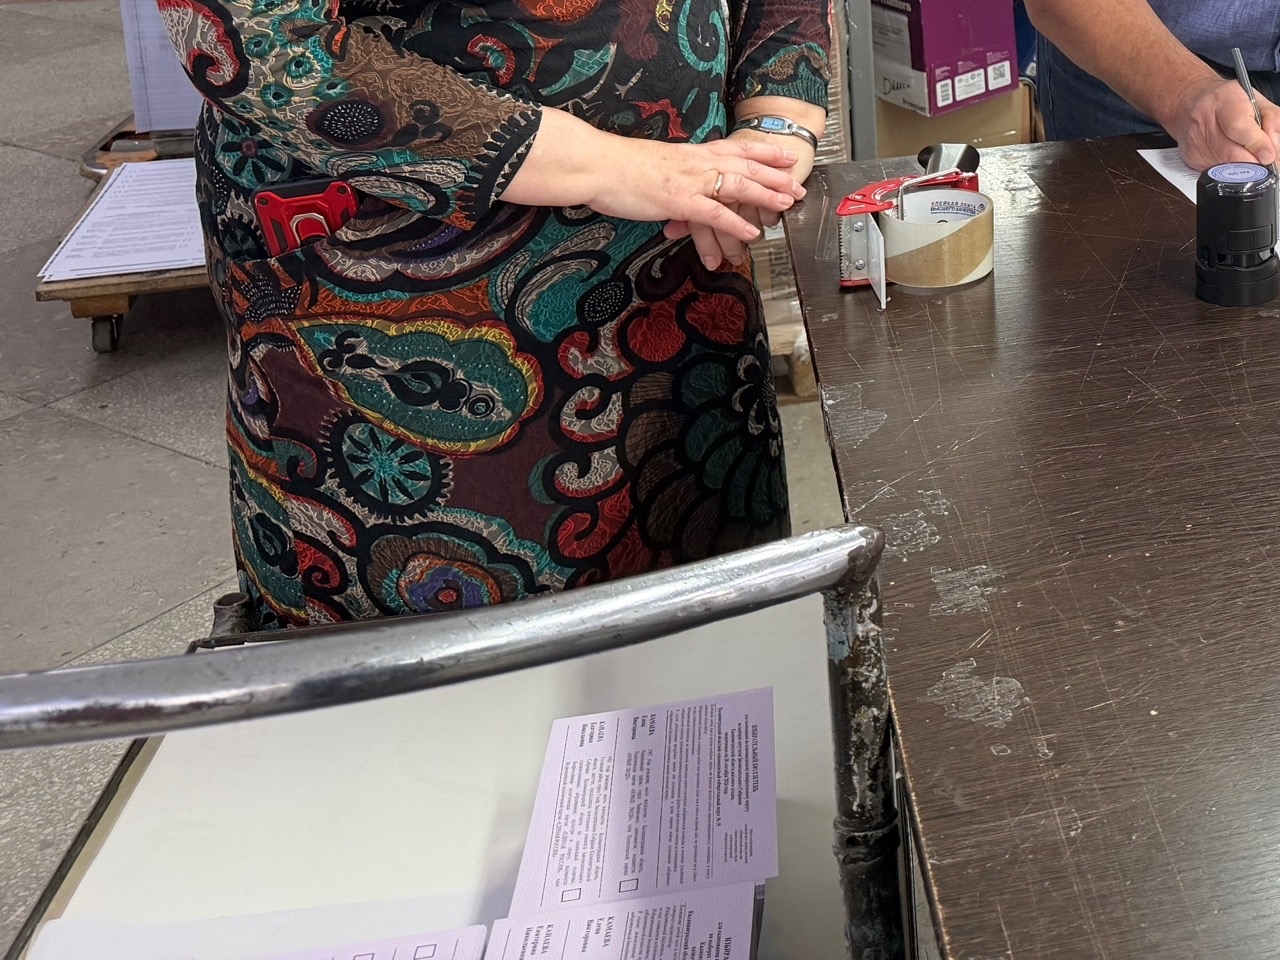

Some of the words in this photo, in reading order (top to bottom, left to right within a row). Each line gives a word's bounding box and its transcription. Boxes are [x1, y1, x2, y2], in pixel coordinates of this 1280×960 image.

[530, 926, 544, 955] Екатерина
[541, 924, 554, 954] КАНАЕВА
[582, 919, 594, 952] Викторовна
[595, 918, 604, 935] Елена
[603, 916, 614, 947] КАМАЕВА
